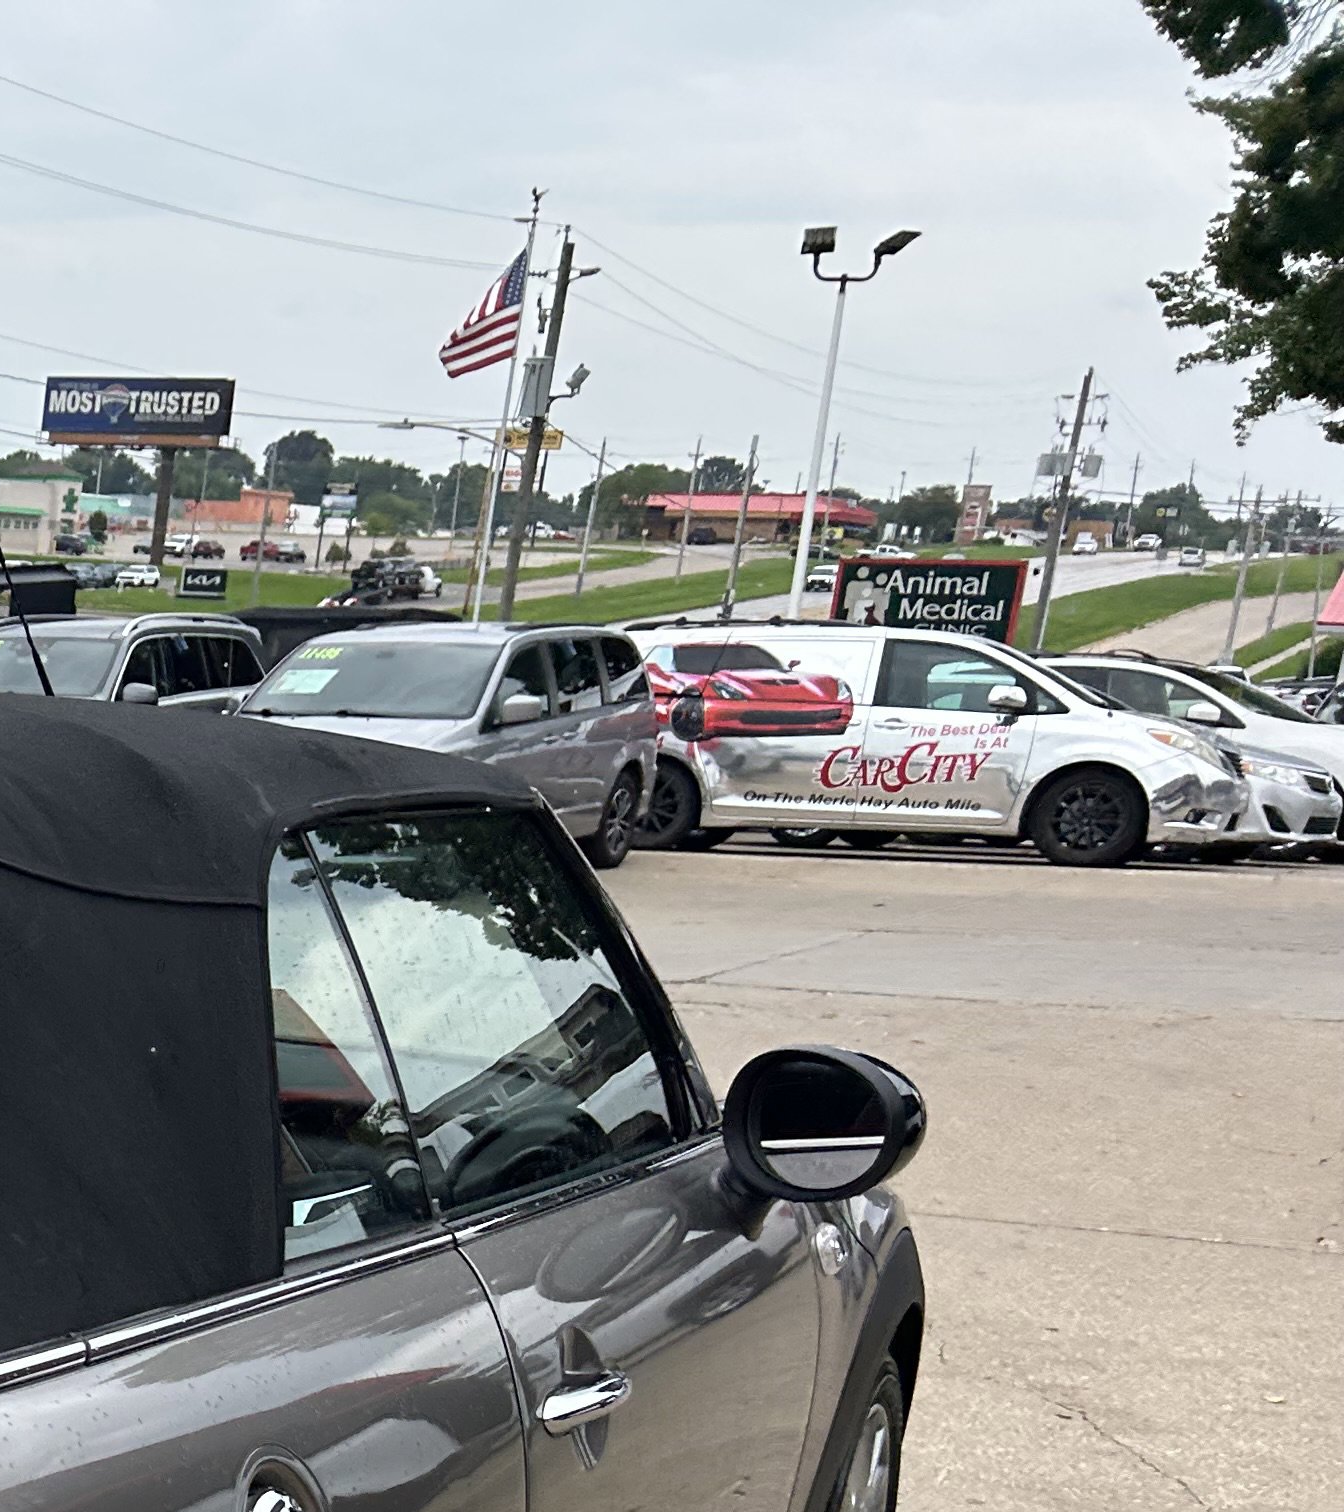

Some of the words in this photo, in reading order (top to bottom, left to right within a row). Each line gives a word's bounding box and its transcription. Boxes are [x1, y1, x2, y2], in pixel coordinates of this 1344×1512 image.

[48, 389, 102, 414] MOST
[128, 390, 220, 416] TRUSTED
[883, 568, 990, 596] Animal
[898, 597, 1005, 622] Medical
[911, 725, 936, 738] The
[940, 724, 976, 737] Best
[978, 723, 1012, 735] Deal
[974, 738, 987, 749] Is
[990, 737, 1009, 749] At
[808, 793, 856, 806] Merle
[859, 795, 894, 810] Hay
[897, 797, 940, 810] Auto
[944, 799, 982, 812] Mile
